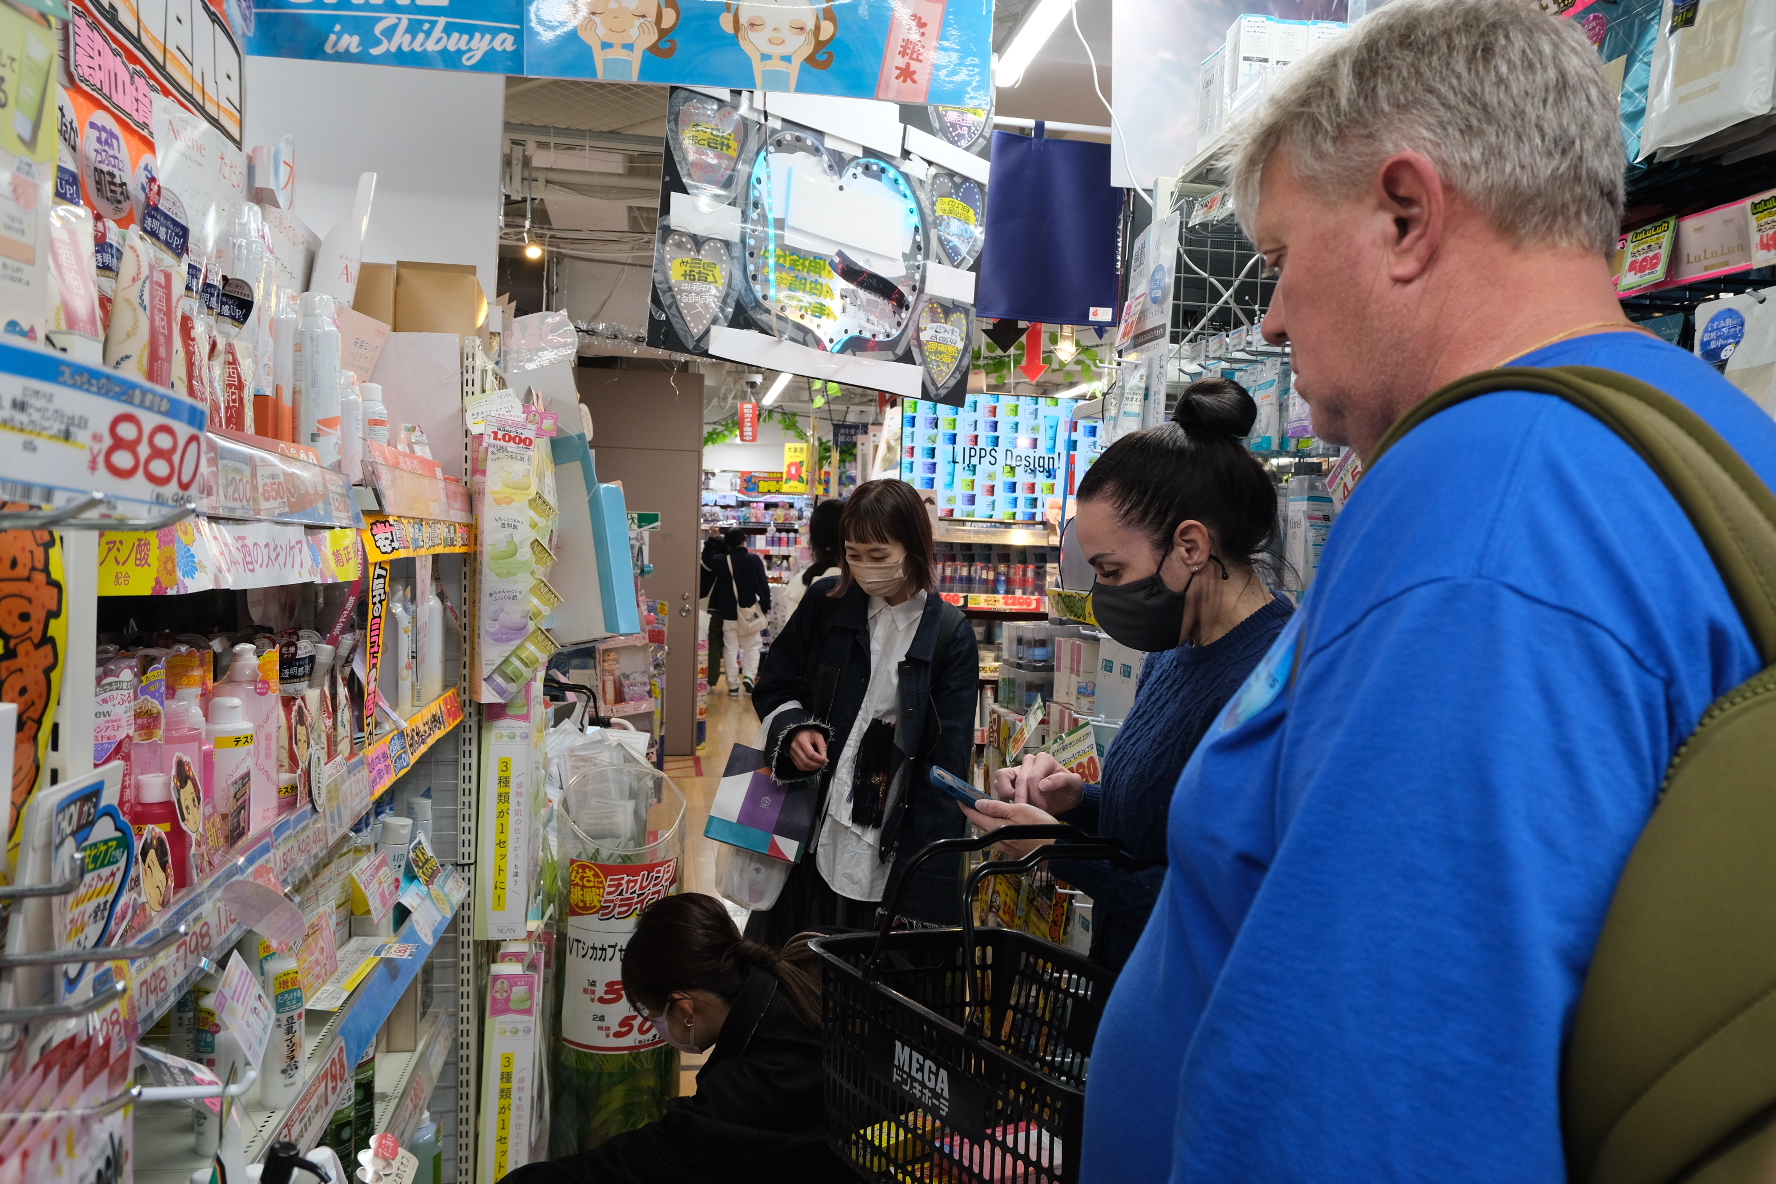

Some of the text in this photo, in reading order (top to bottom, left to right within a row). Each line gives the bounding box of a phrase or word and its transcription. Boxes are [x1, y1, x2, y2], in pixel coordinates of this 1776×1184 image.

[324, 16, 518, 66] in Shibuya
[1686, 243, 1745, 265] LuLuLun
[951, 446, 1062, 475] LIPPS Design!
[99, 537, 152, 569] アミノ酸
[213, 536, 305, 575] 日本酒のスキンケア
[114, 571, 131, 586] 配合
[536, 582, 560, 608] NUAN
[533, 631, 556, 654] NUAN
[494, 759, 511, 908] 3種類が1セットに!
[512, 780, 525, 887] 感触も肌の仕上がりも違う
[569, 865, 603, 888] 安さに
[605, 859, 678, 896] チャレンジ
[176, 920, 213, 970] 798
[496, 926, 516, 934] NUAN
[138, 967, 169, 1006] 798
[277, 989, 302, 1004] とろける
[323, 1045, 346, 1109] 798
[894, 1040, 949, 1099] MEGA
